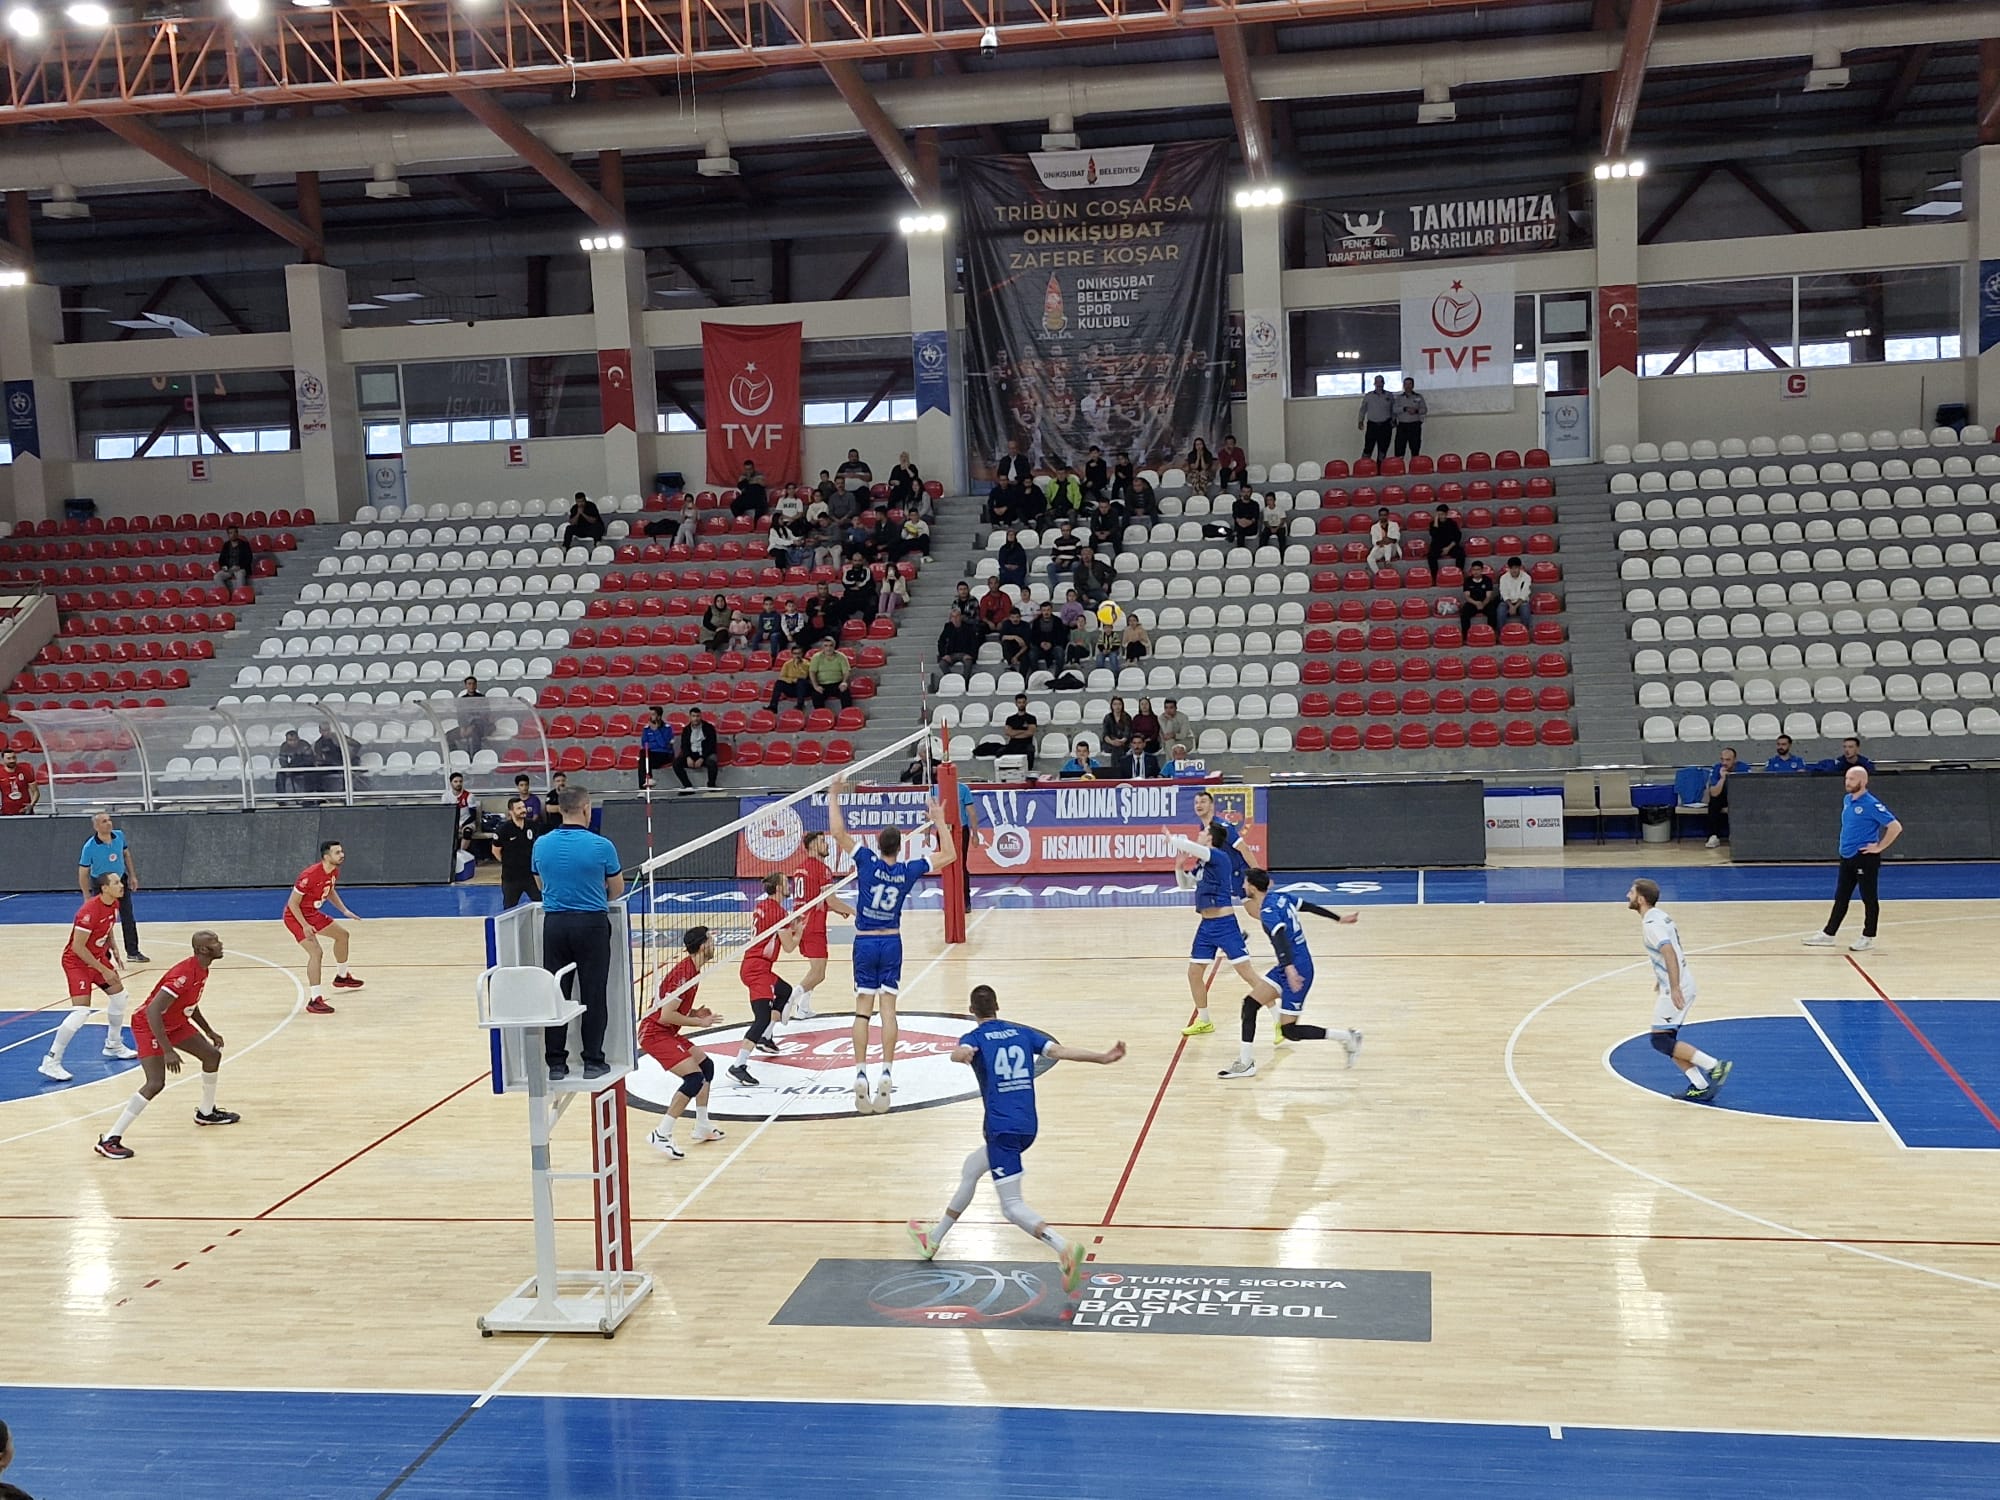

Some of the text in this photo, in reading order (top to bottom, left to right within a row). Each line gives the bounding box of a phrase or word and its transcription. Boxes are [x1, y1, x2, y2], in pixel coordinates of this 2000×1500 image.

[994, 195, 1193, 222] TRİBÜN COŞARSA
[1409, 194, 1555, 232] TAKIMIMIZA
[1023, 220, 1165, 245] ONİKİŞUBAT
[1373, 237, 1387, 247] 46
[1410, 221, 1556, 255] BAŞARILAR DİLERİZ
[1009, 245, 1179, 269] ZAFERE KOŞAR
[1327, 248, 1404, 263] TARAFTAR GRUBU
[1078, 303, 1112, 316] SPOR
[1422, 345, 1492, 374] TVF
[1788, 374, 1806, 393] G
[721, 424, 782, 449] TVF
[509, 445, 523, 462] E
[191, 460, 206, 477] E
[1056, 788, 1118, 819] KADINA
[870, 884, 899, 911] 13
[79, 980, 86, 990] 2
[151, 1038, 158, 1049] 5
[994, 1045, 1029, 1080] 42
[1087, 1286, 1265, 1303] TÜRKİYE
[924, 1311, 968, 1320] TBF
[1078, 1299, 1338, 1319] BASKETBOL
